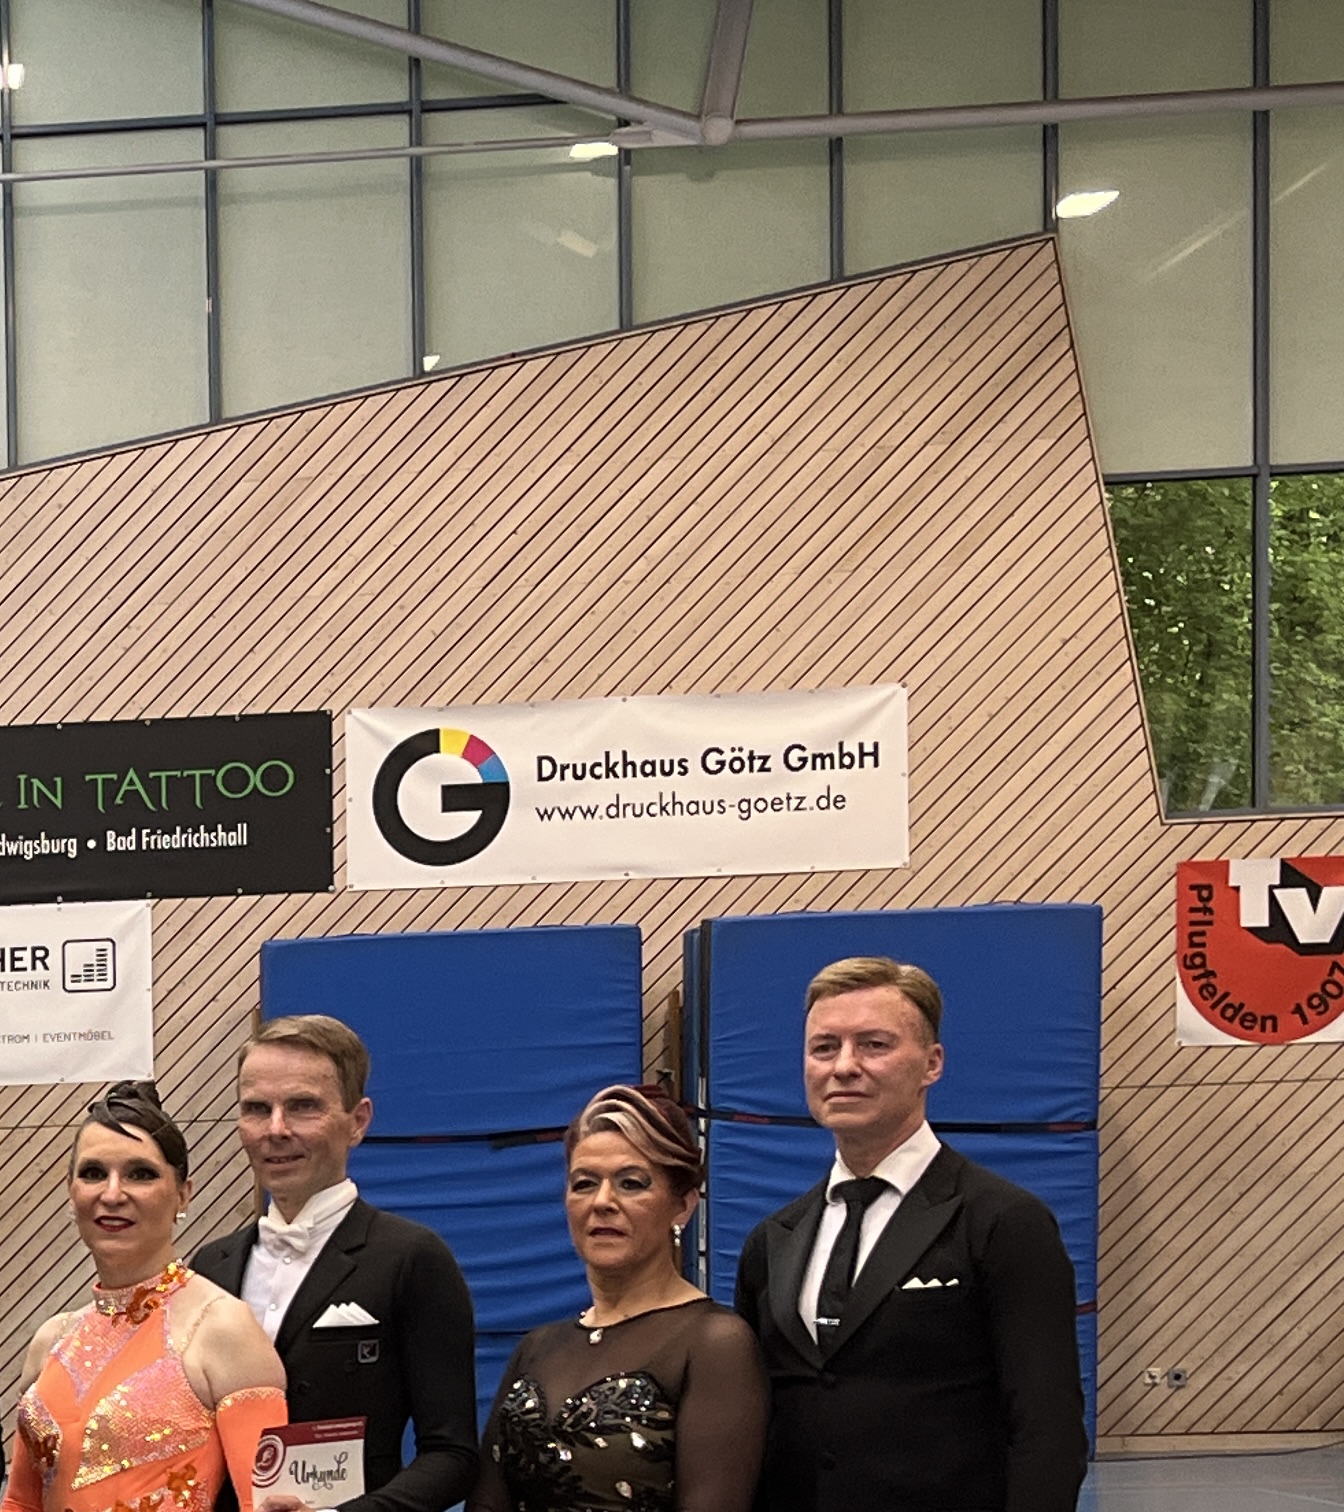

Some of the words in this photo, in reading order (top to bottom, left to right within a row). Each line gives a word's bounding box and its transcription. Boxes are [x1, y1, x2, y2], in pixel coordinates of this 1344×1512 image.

[536, 750, 690, 782] Druckhaus
[700, 745, 772, 776] Götz
[782, 740, 880, 772] GmbH
[17, 773, 62, 810] IN
[84, 759, 295, 814] TATTOO
[535, 784, 847, 822] www.druckhaus-goetz.de
[105, 828, 136, 852] Bad
[141, 822, 248, 851] Friedrichshall
[1182, 883, 1279, 1033] Pflugfelden
[1291, 960, 1344, 1026] 1907
[42, 1029, 114, 1044] EVENTMÖBEL
[288, 1451, 349, 1490] Urkunde
